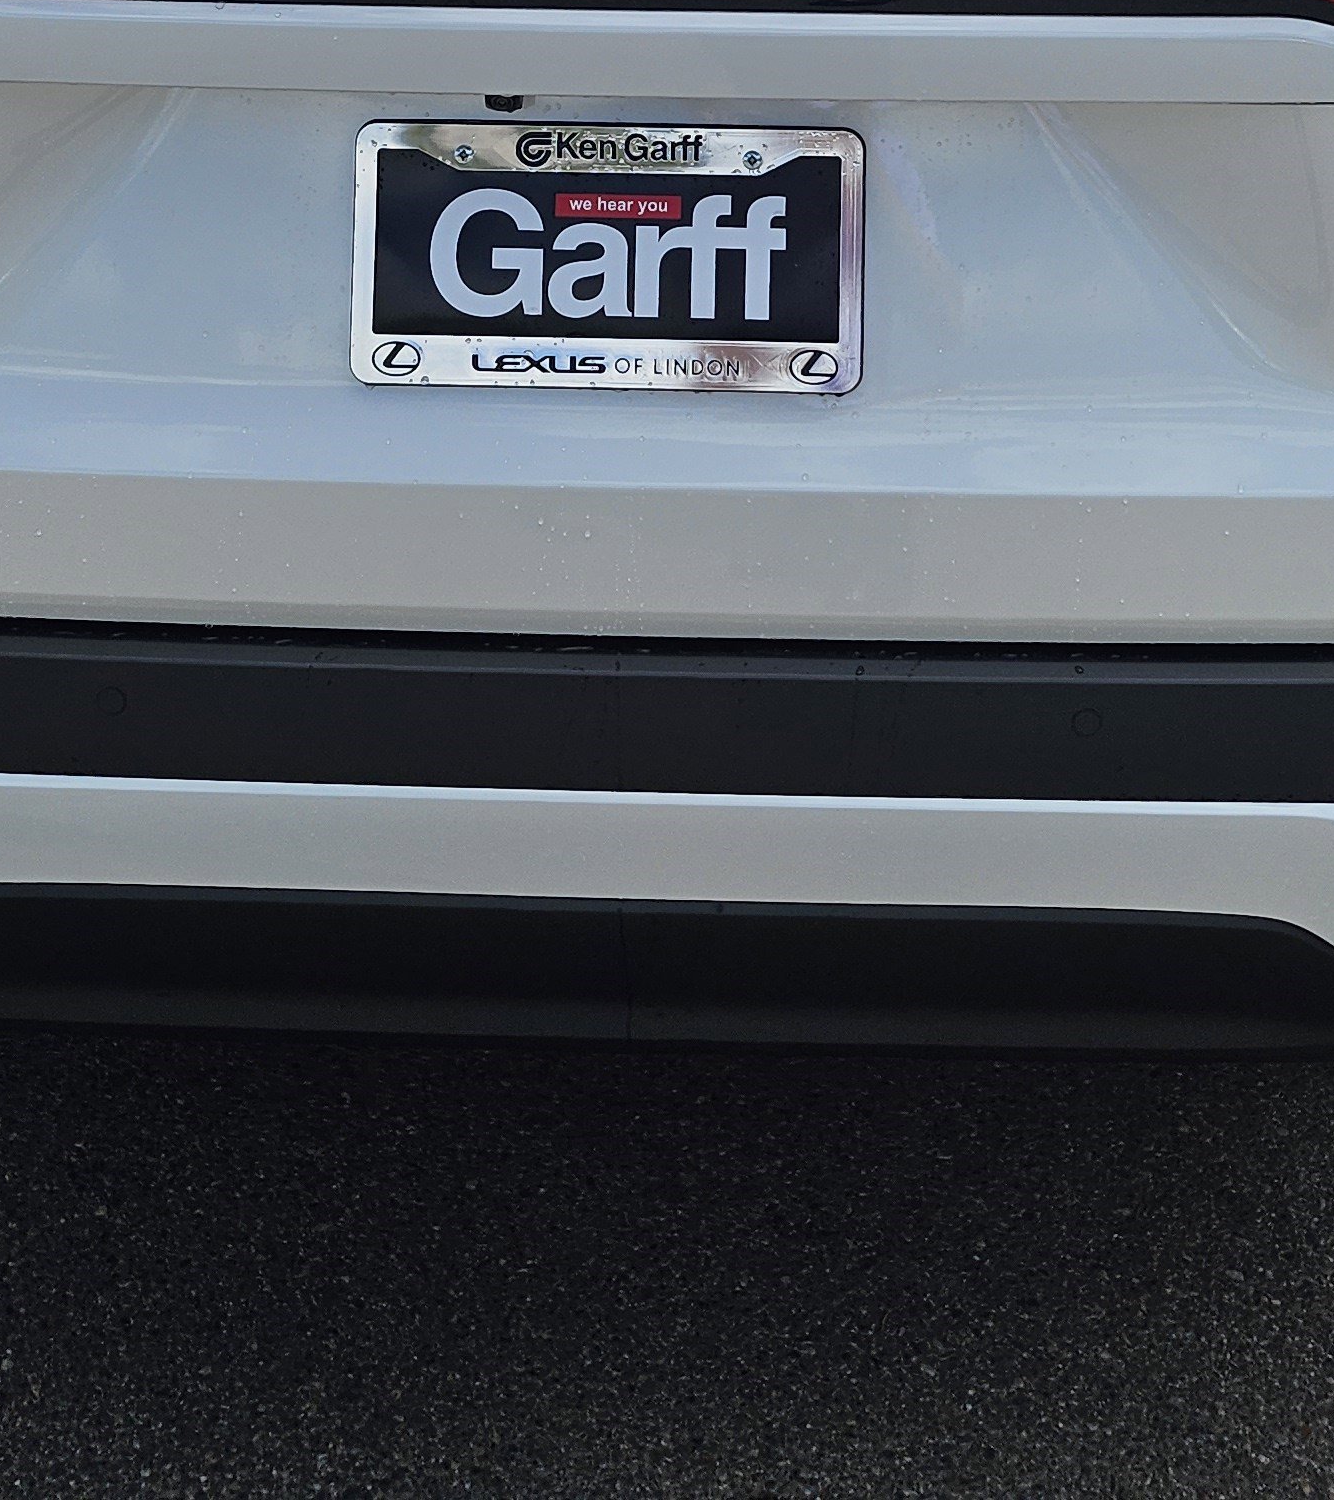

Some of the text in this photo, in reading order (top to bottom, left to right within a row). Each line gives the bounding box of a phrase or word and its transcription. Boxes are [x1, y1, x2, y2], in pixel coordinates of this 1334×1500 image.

[556, 132, 703, 162] Ken Garff
[569, 197, 668, 215] we hear you
[429, 188, 786, 320] Garff
[472, 354, 740, 377] LEXUS OF LINDON
